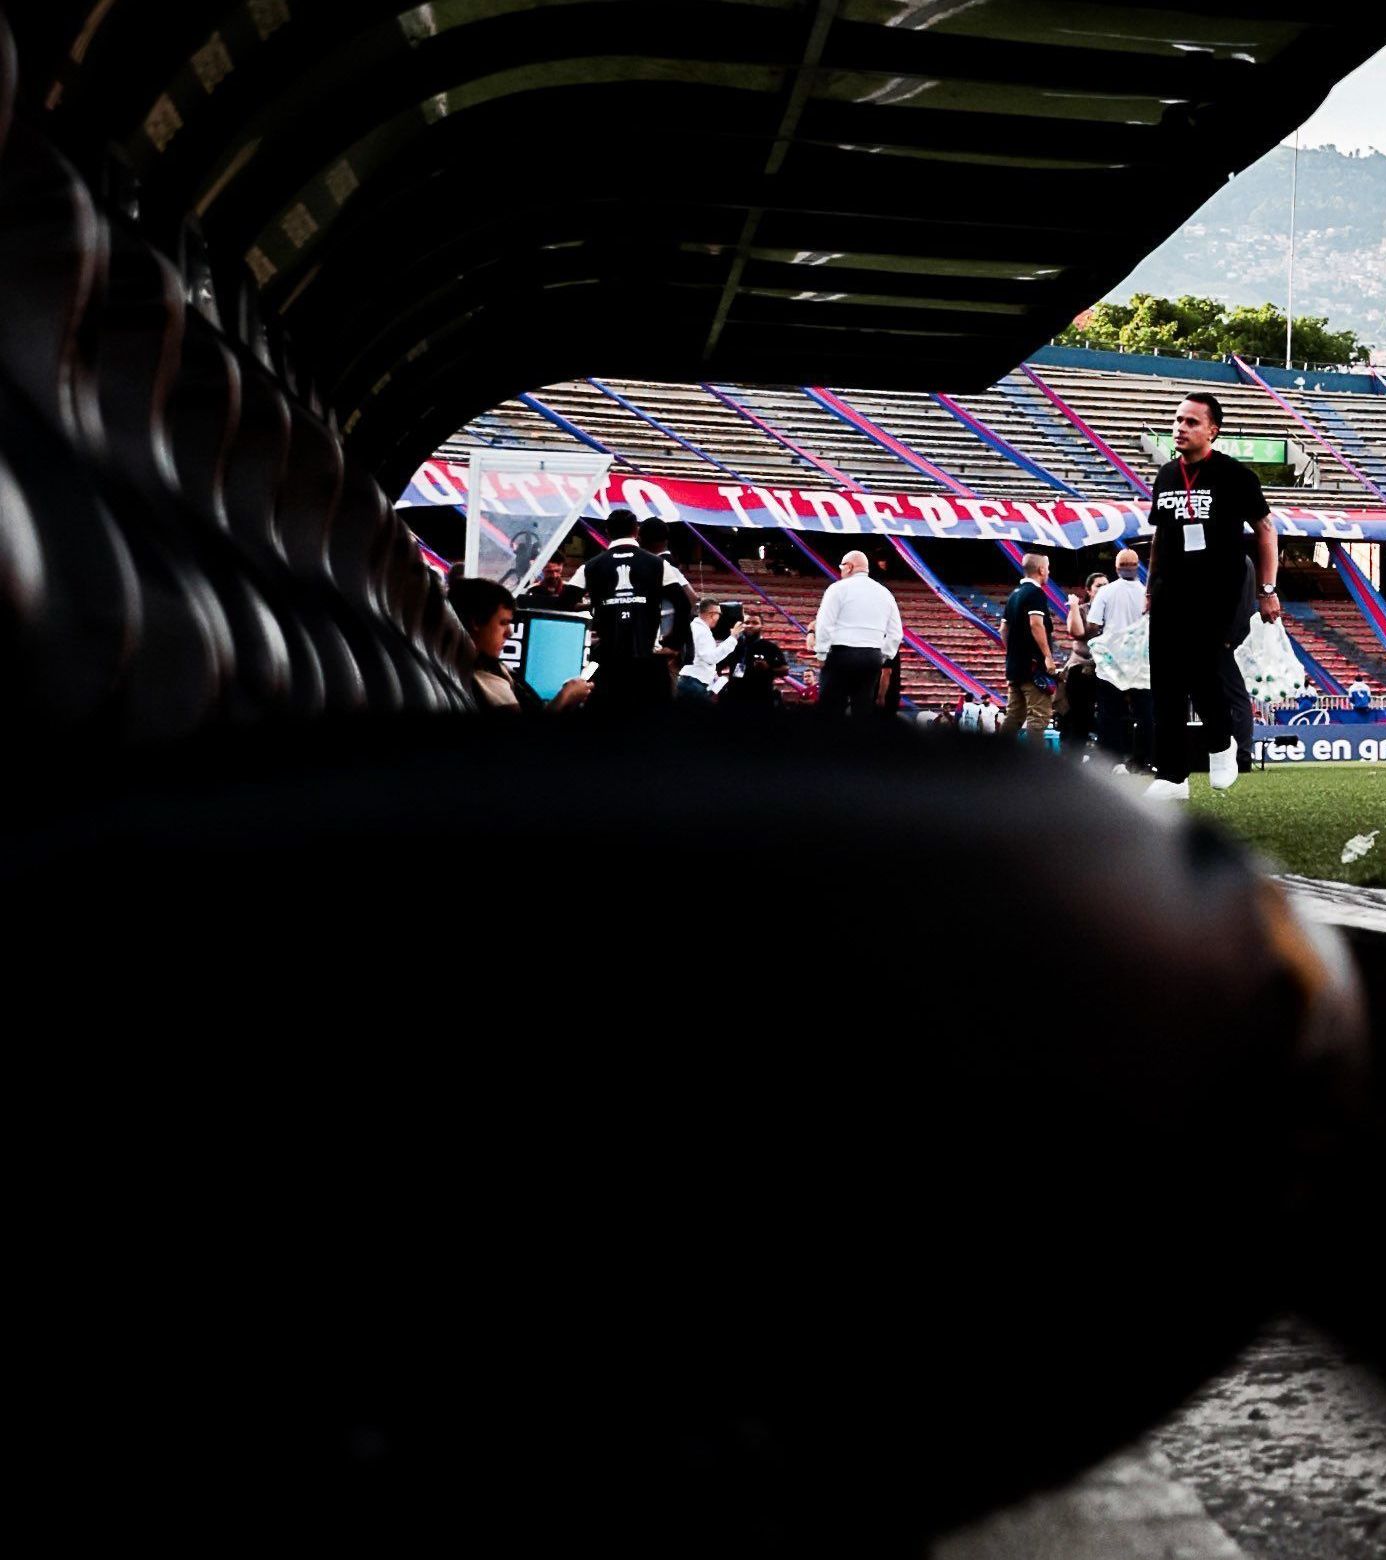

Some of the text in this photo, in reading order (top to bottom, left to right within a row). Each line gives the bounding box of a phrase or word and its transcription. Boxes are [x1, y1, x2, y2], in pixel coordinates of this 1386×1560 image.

[1157, 494, 1213, 511] POWER
[621, 611, 630, 619] 21
[1312, 738, 1351, 761] en
